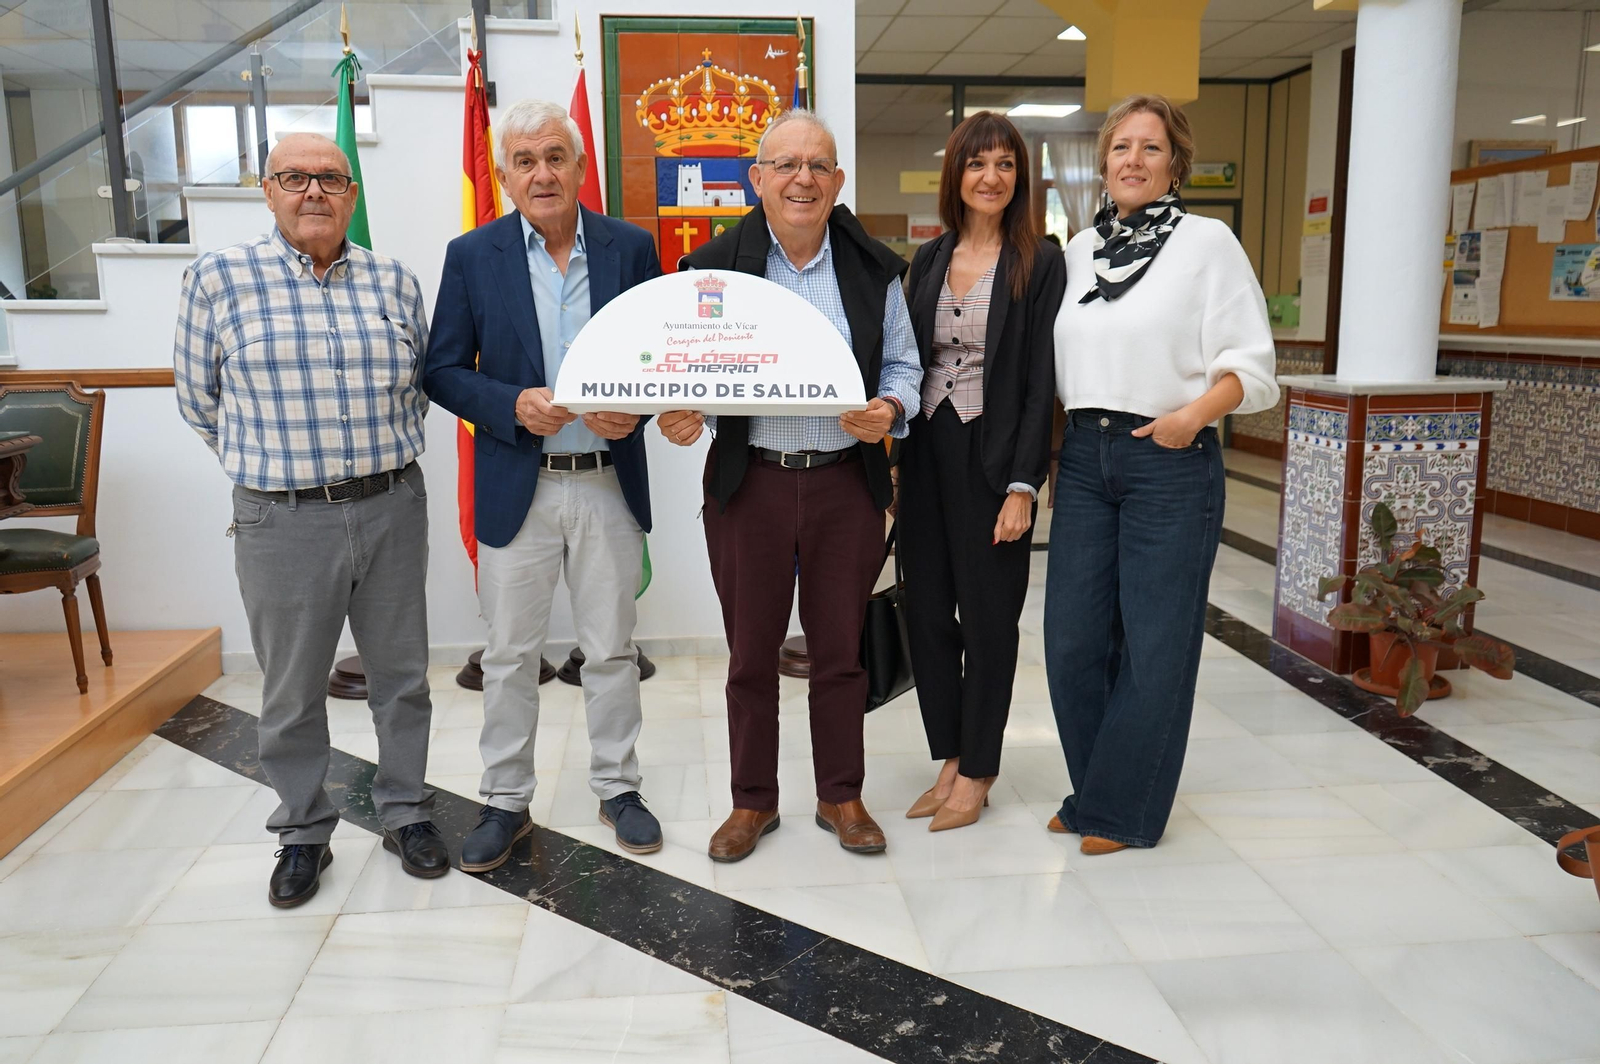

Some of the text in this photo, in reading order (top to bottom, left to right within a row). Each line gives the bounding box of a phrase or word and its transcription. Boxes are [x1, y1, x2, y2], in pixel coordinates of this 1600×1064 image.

[662, 321, 758, 331] Ayuntamiento de Vícar
[666, 332, 754, 347] Corazón del Poniente
[581, 382, 838, 398] MUNICIPIO DE SALIDA
